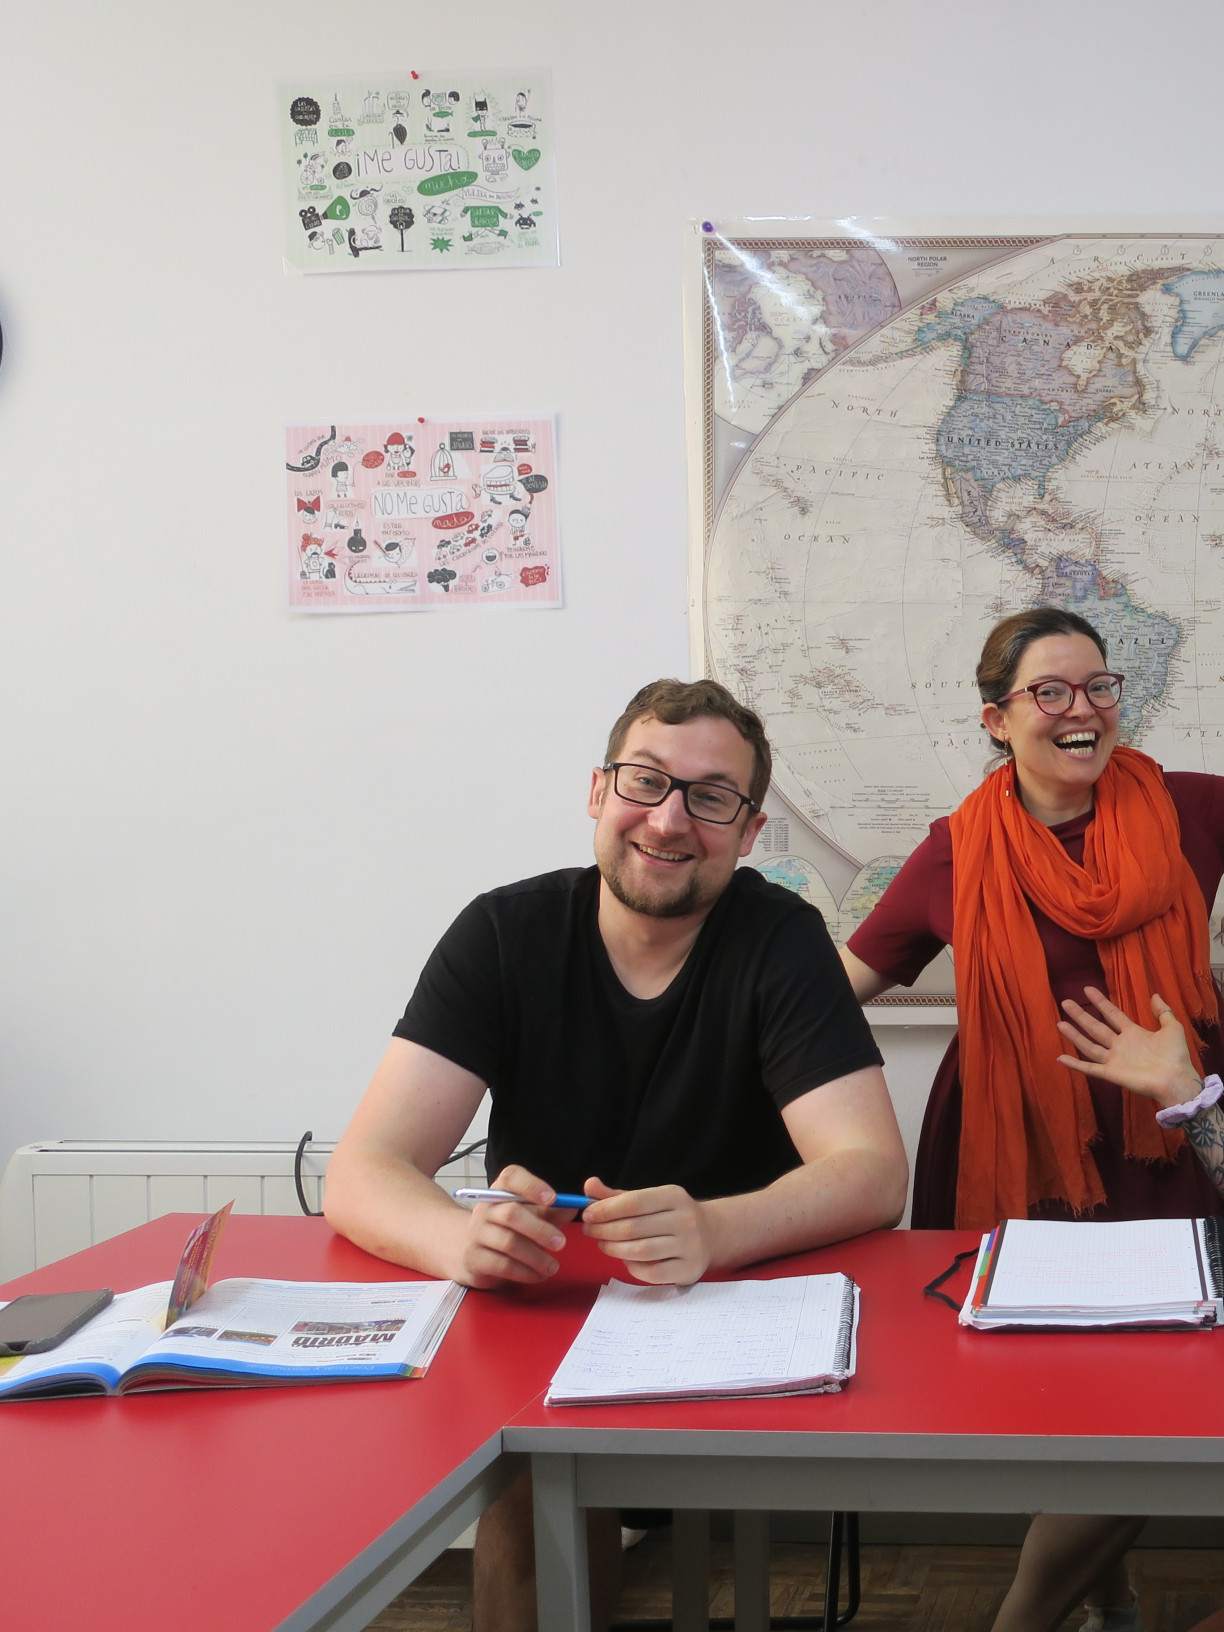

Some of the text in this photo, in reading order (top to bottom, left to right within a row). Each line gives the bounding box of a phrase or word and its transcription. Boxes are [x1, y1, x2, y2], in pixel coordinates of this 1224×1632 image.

[951, 311, 975, 320] ALASKA
[1001, 335, 1114, 352] CANADA
[832, 400, 898, 418] NORTH
[947, 436, 1059, 450] UNITED STATES
[796, 464, 884, 481] PACIFIC
[374, 492, 394, 515] NO
[433, 515, 471, 527] nada
[1135, 515, 1201, 523] OCEAN
[784, 533, 851, 544] OCEAN
[911, 681, 978, 689] SOUTH
[292, 1333, 395, 1347] MADRID
